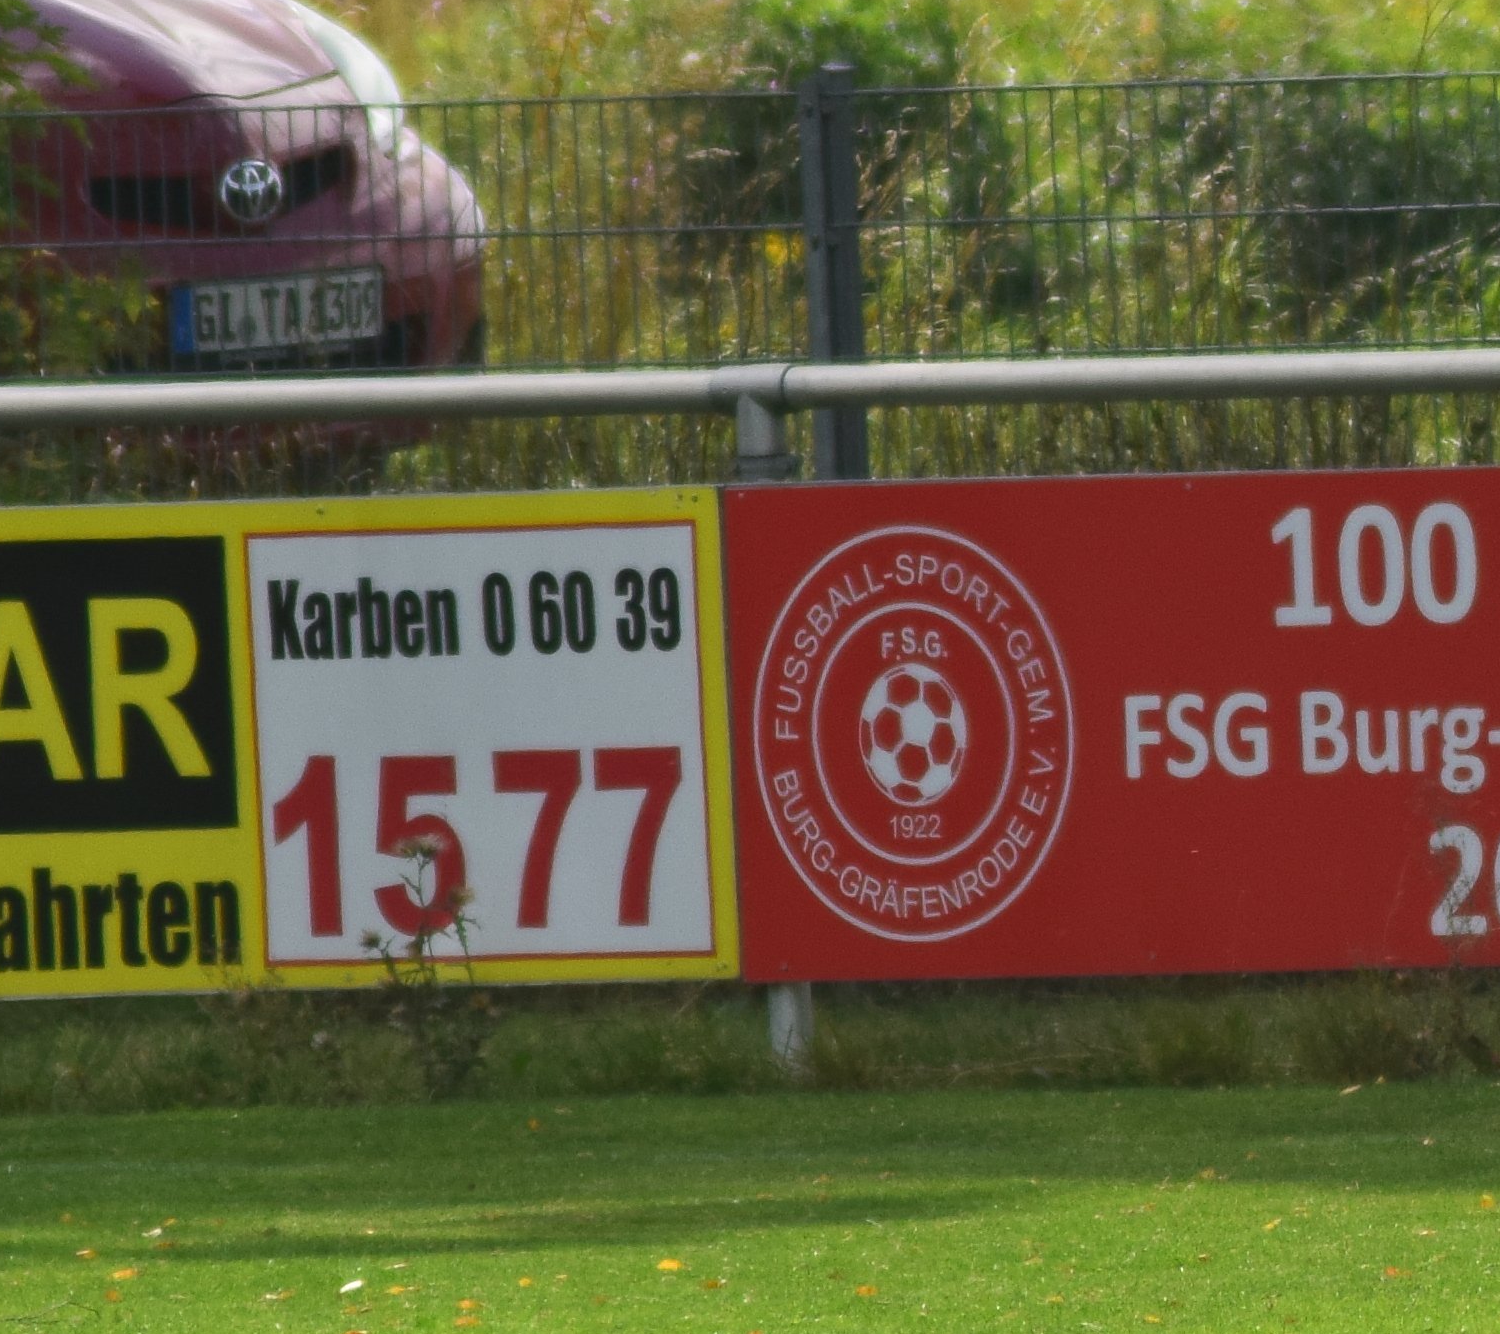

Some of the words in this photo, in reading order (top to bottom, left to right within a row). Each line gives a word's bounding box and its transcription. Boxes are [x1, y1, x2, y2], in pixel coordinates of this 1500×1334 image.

[1271, 501, 1478, 627] 100
[267, 576, 460, 661] Karben
[481, 572, 516, 657] 0
[528, 570, 597, 655] 60
[614, 567, 682, 652] 39
[880, 626, 949, 661] F.S.G.
[1124, 691, 1270, 780] FSG
[273, 746, 683, 937] 1577
[889, 814, 942, 840] 1922
